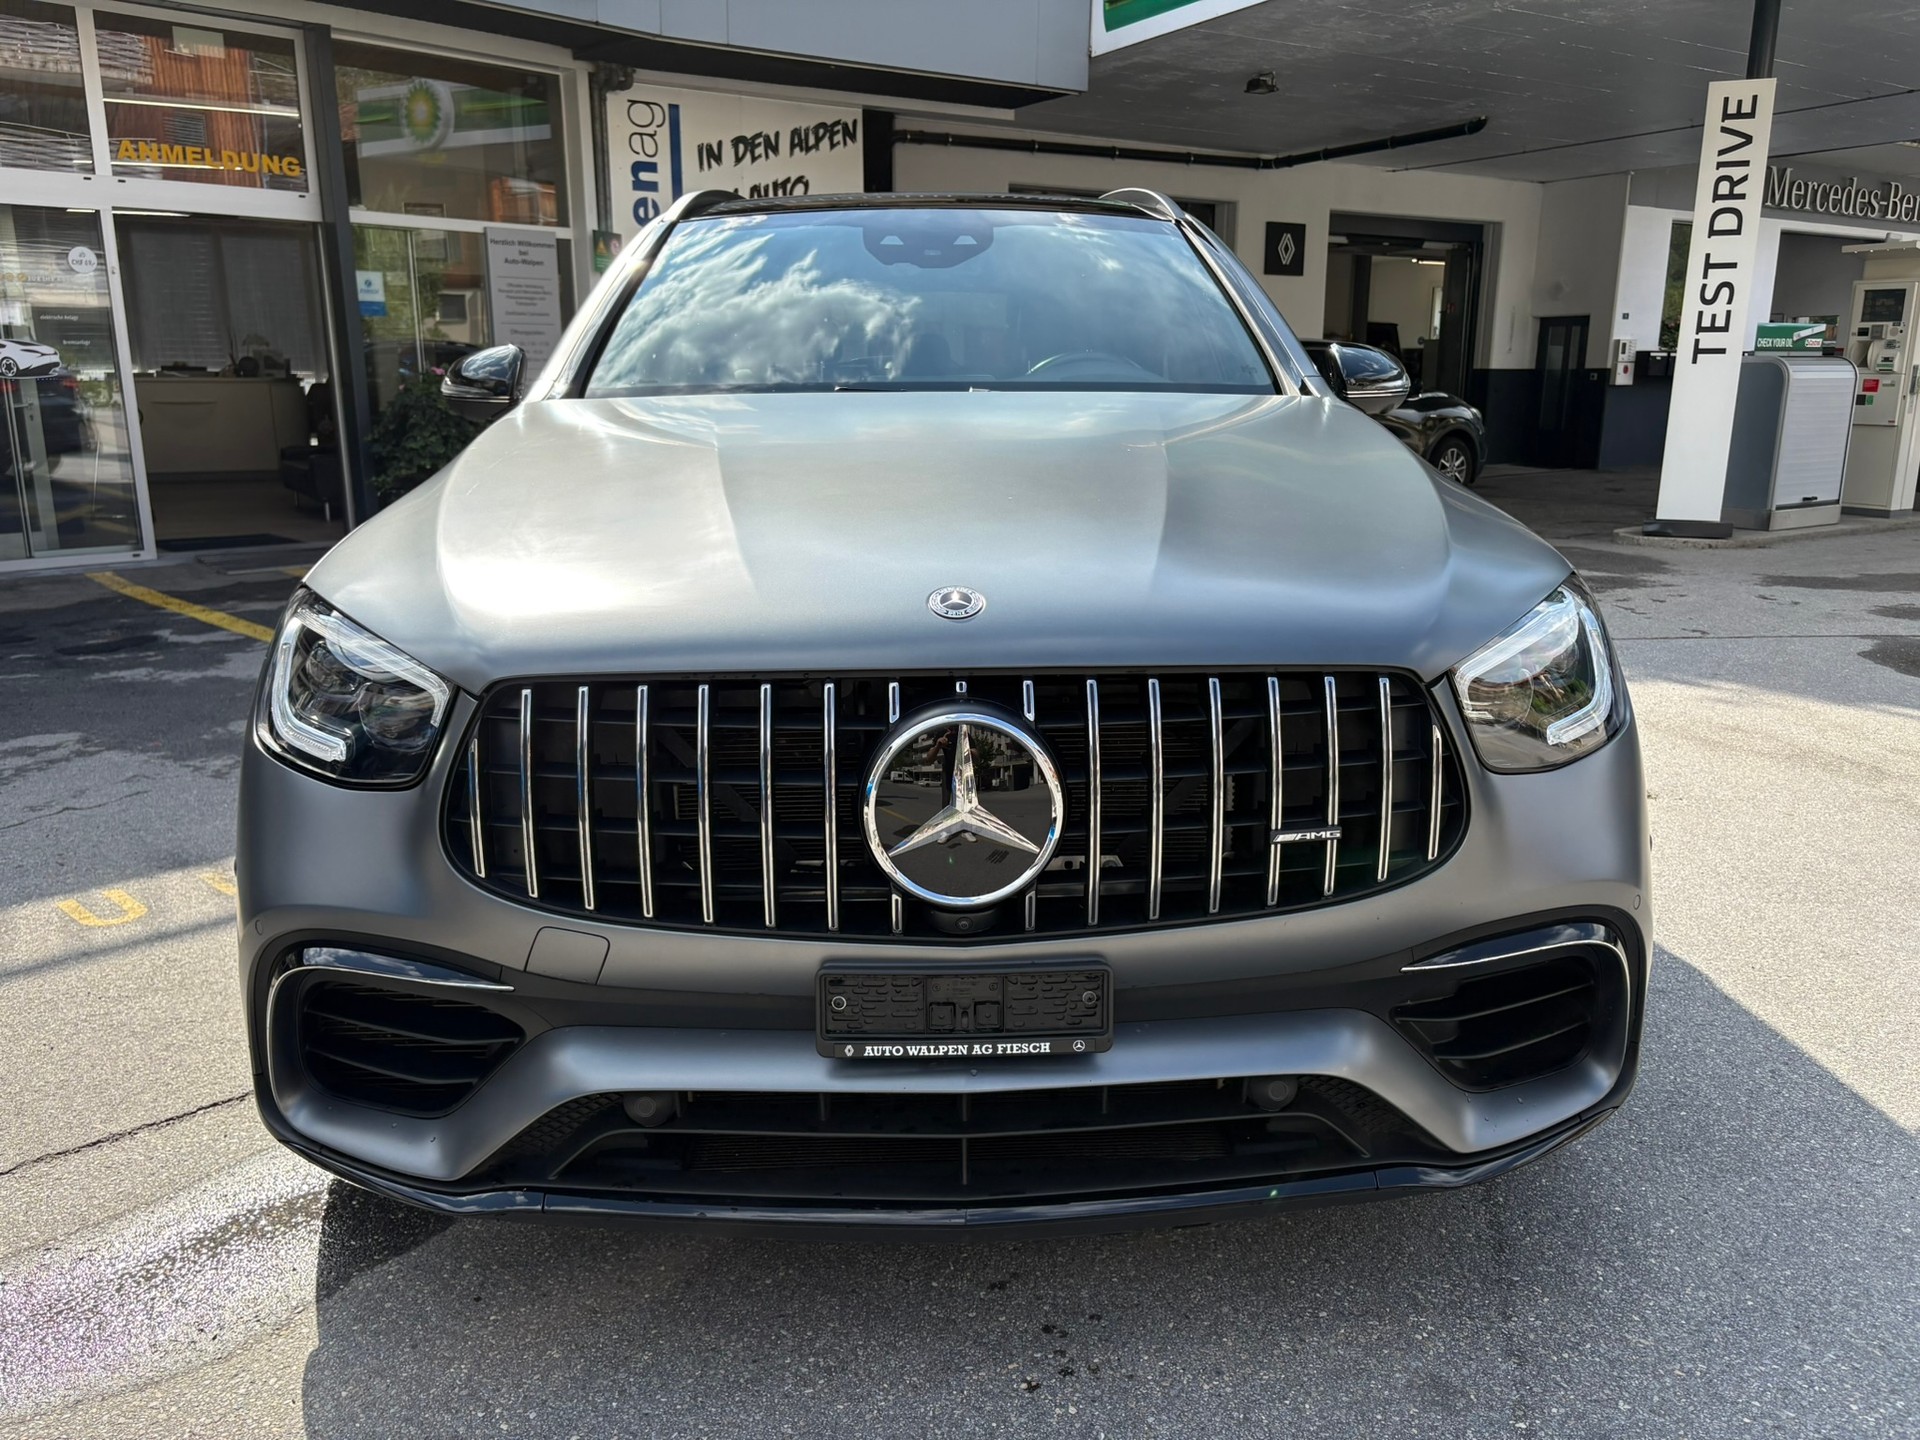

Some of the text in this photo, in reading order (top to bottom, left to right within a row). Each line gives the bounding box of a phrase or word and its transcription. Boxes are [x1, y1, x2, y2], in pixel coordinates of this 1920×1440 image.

[697, 118, 858, 172] IN DEN ALPEN
[116, 139, 302, 177] ANMELDUNG
[1691, 94, 1758, 364] TEST DRIVE
[489, 239, 556, 249] Herzlich Willkommen
[504, 257, 545, 267] Auto-Walpen
[1757, 338, 1772, 347] CHECK
[1773, 338, 1785, 347] YOUR
[1295, 830, 1341, 840] AMG
[863, 1042, 1051, 1057] AUTO WALPEN AG FIESCH
